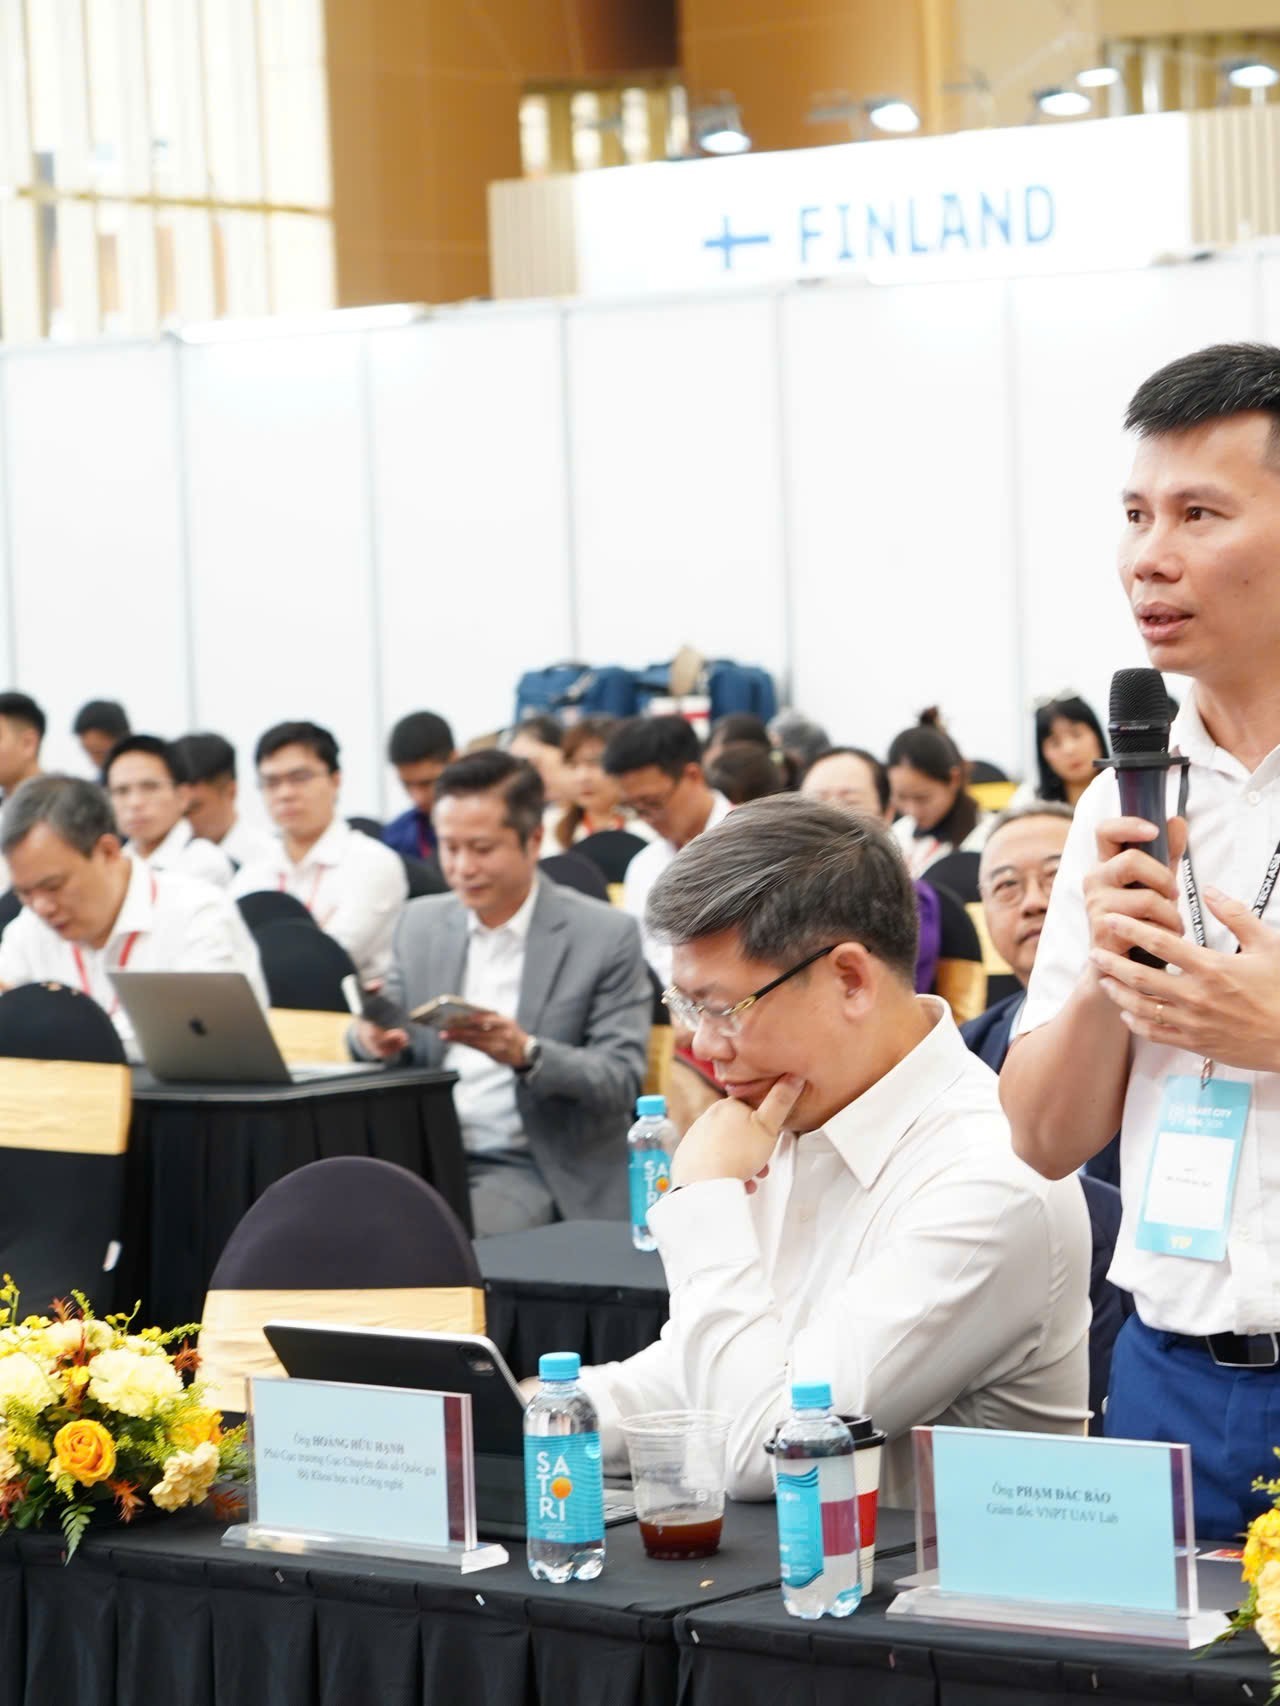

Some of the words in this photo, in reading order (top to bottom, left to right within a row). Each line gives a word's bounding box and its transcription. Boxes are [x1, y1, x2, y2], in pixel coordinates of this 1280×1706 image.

[798, 183, 1056, 264] FINLAND
[1016, 1485, 1053, 1501] PHẠM
[1036, 1505, 1068, 1520] VNPT
[1070, 1507, 1096, 1522] UAV
[1099, 1510, 1120, 1524] Lab
